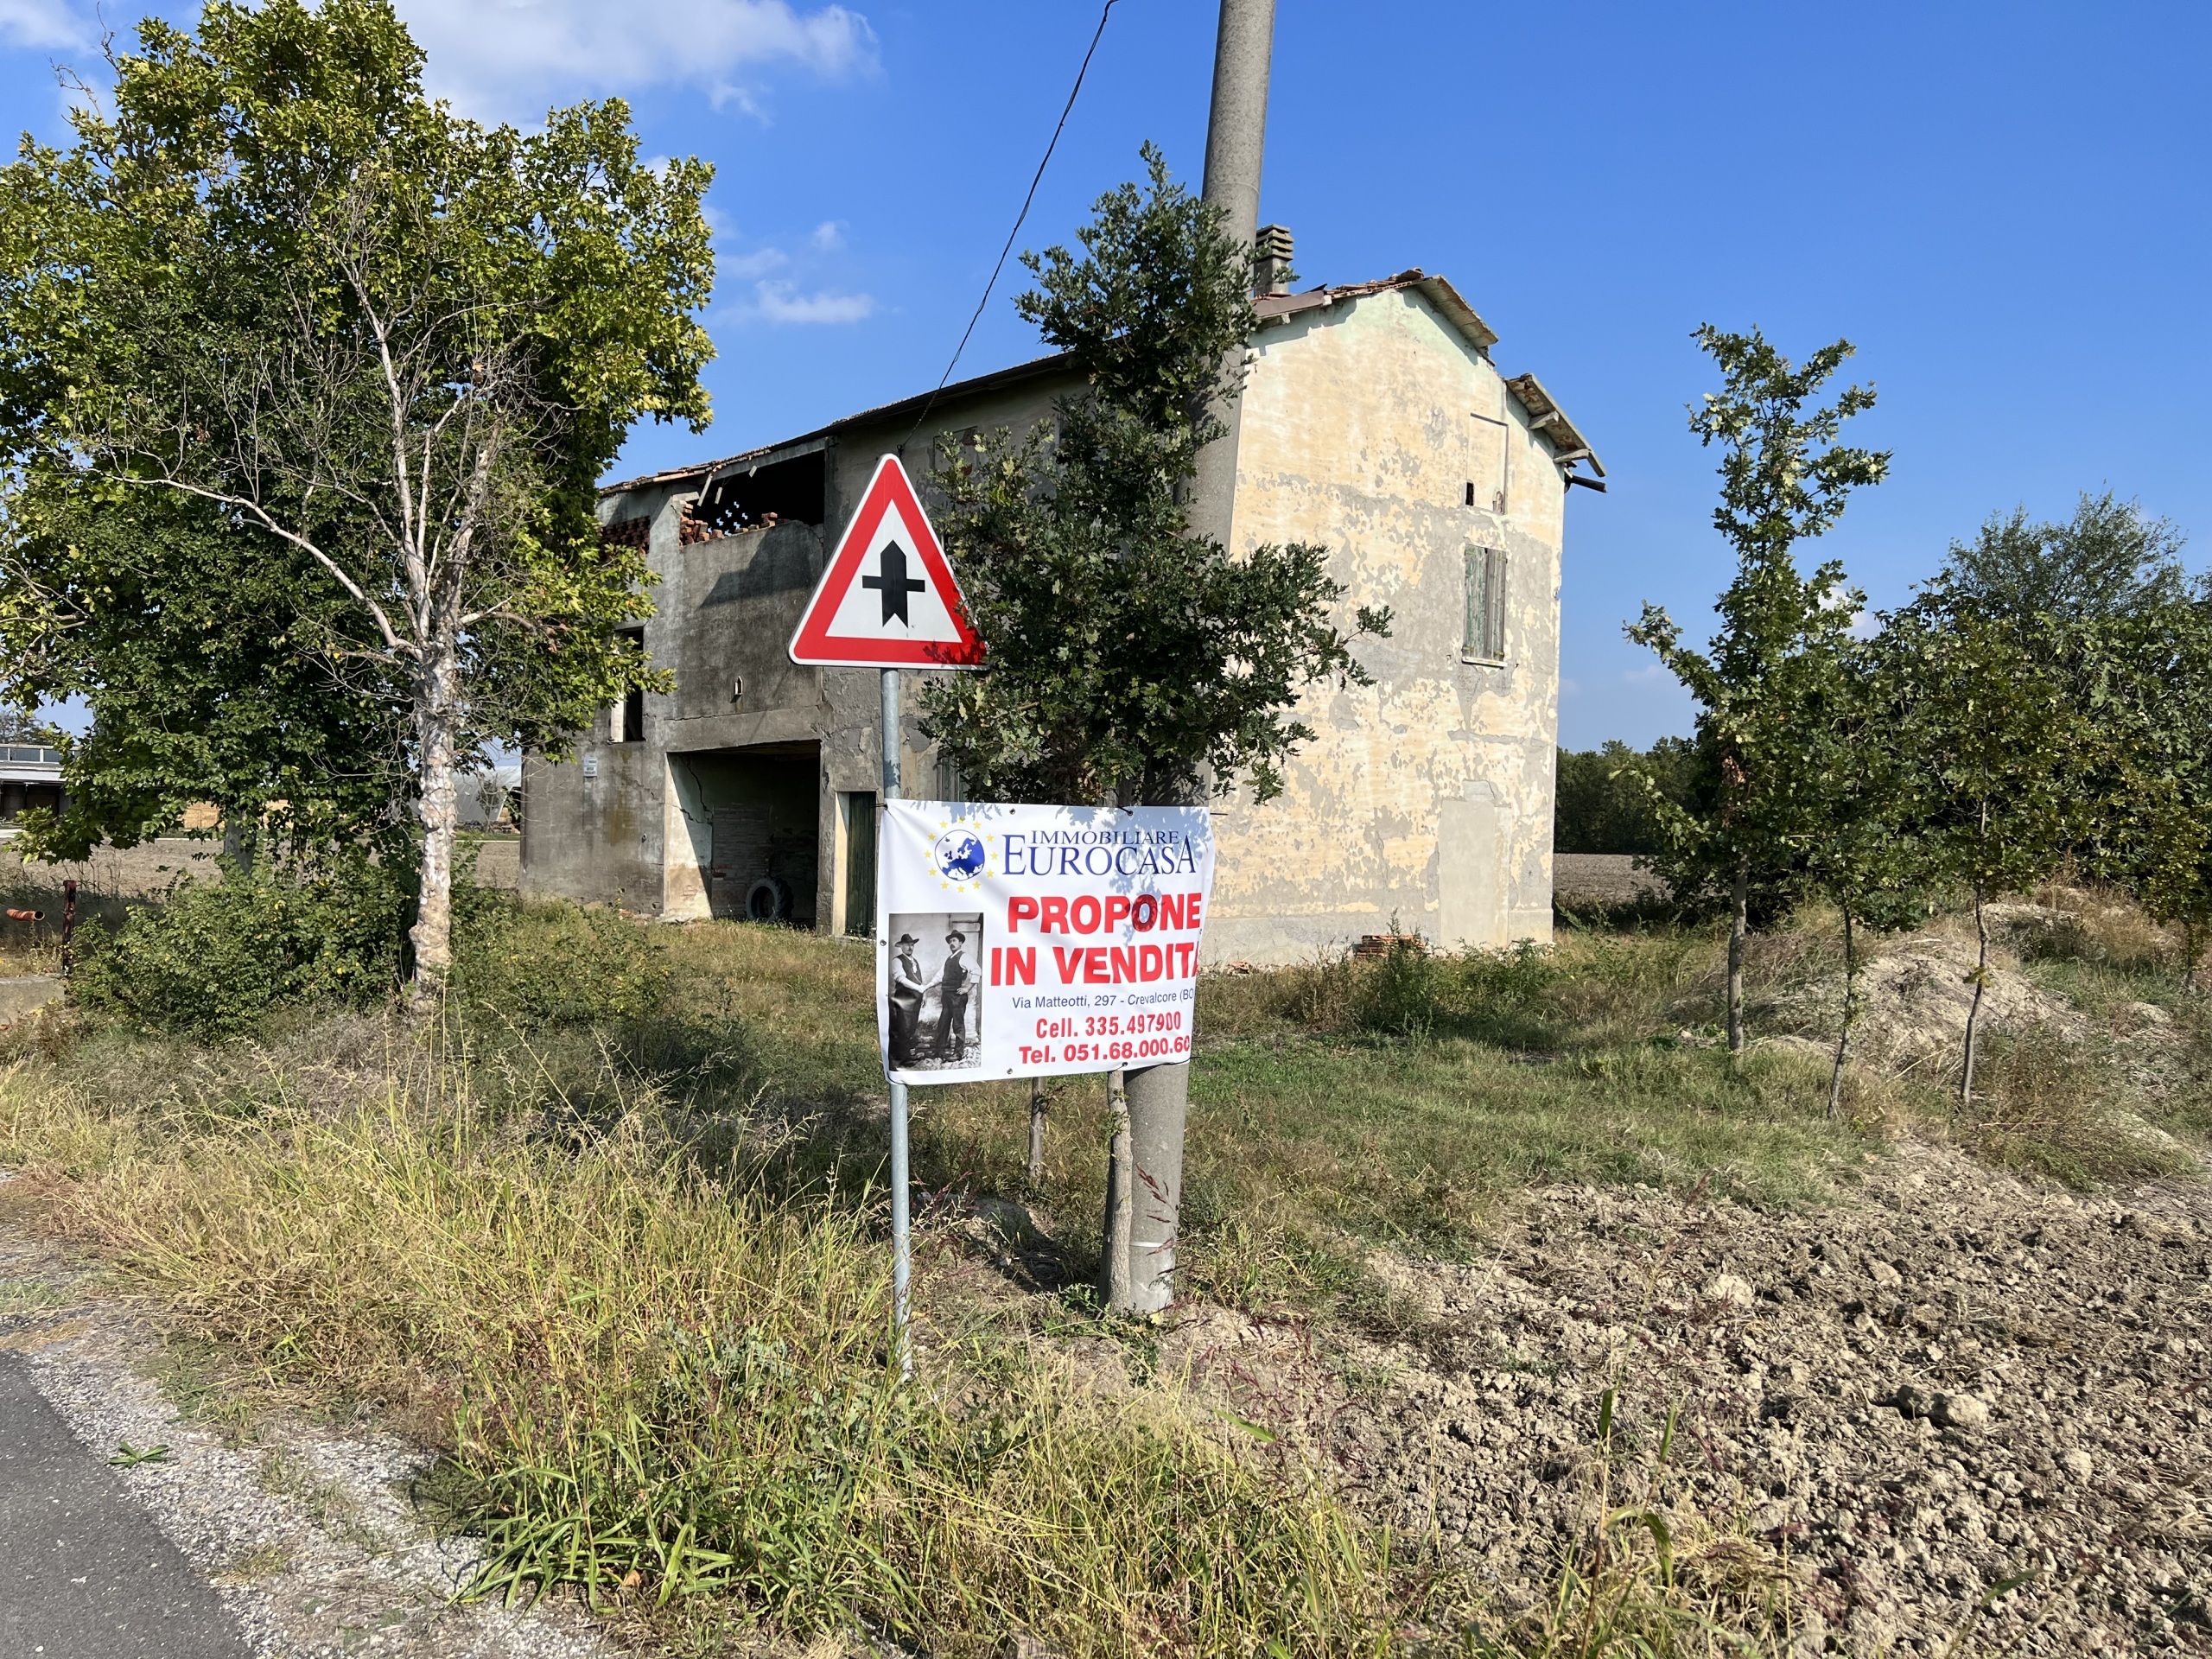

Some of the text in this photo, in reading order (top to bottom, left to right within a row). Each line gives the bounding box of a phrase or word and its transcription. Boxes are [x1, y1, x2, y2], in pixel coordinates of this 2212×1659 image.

[1032, 830, 1179, 845] IMMOBILIARE
[1001, 834, 1197, 875] EUROCASA
[1007, 893, 1202, 934] PROPONE
[990, 947, 1036, 986] IN
[1012, 996, 1031, 1008] Via
[1035, 995, 1090, 1008] Matteotti,
[1094, 995, 1116, 1007] 297
[1128, 992, 1177, 1005] Crevalcore
[1036, 1011, 1181, 1039] Cell. 335.497900
[1019, 1045, 1056, 1064] Tel.
